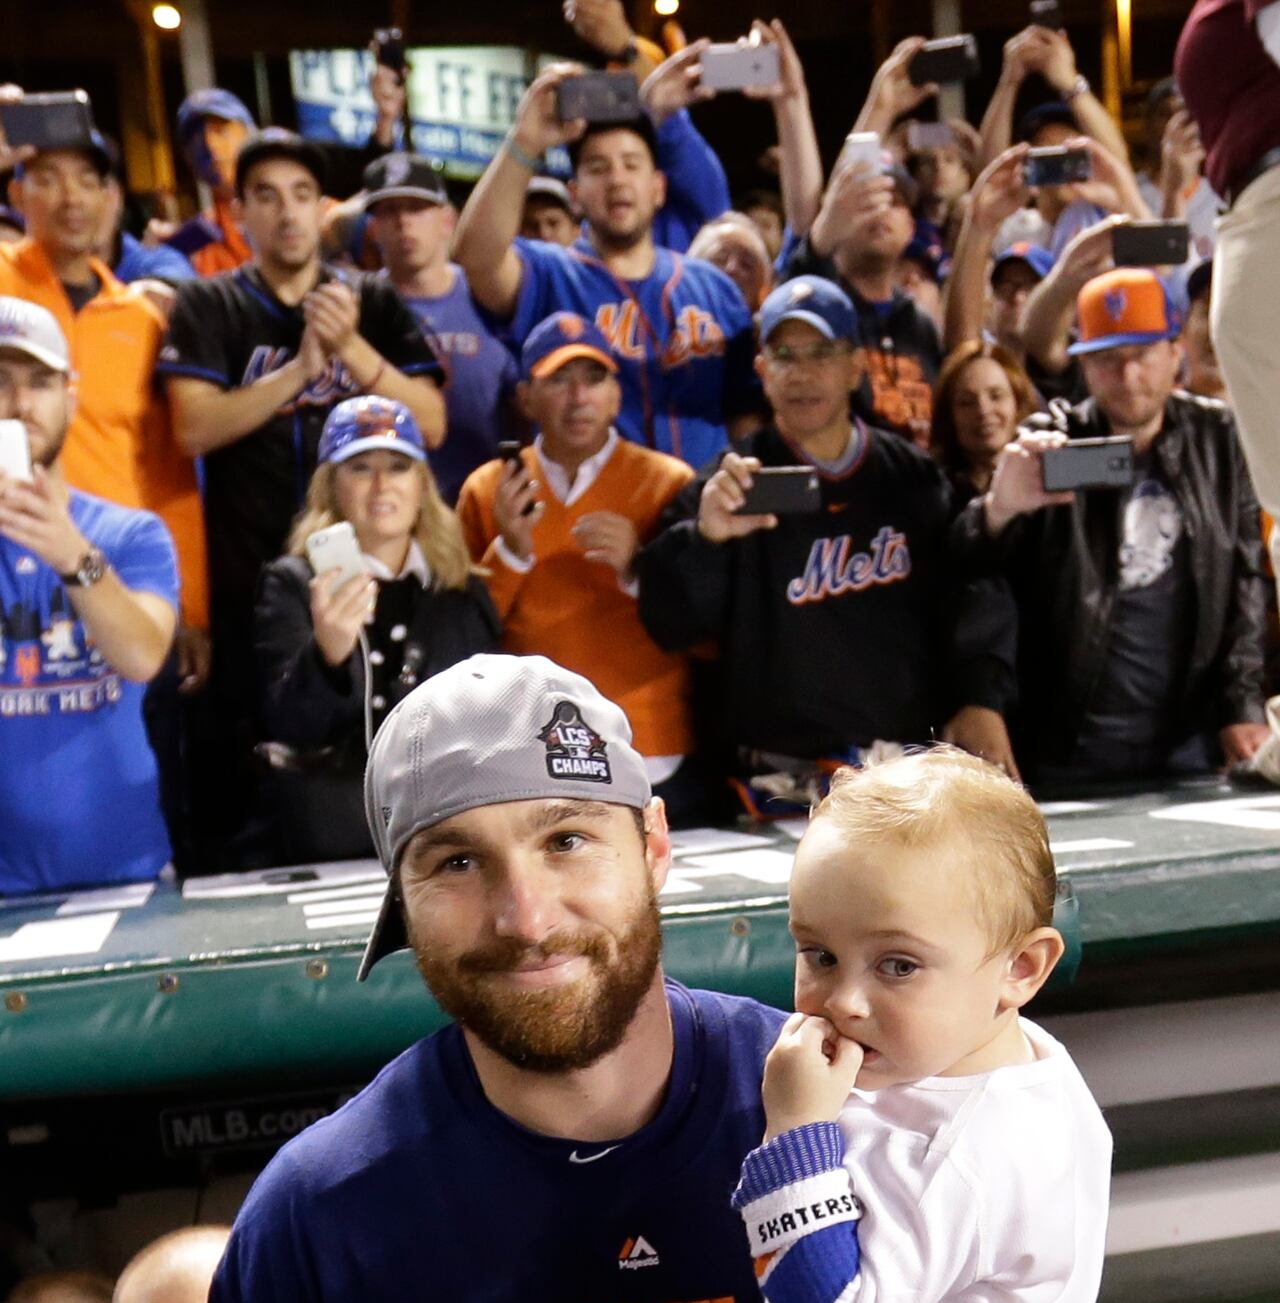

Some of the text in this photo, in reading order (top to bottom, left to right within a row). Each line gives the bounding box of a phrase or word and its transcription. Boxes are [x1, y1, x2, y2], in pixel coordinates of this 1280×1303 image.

[787, 525, 913, 605] Mets
[556, 727, 591, 746] LCS
[552, 758, 608, 777] CHAMPS
